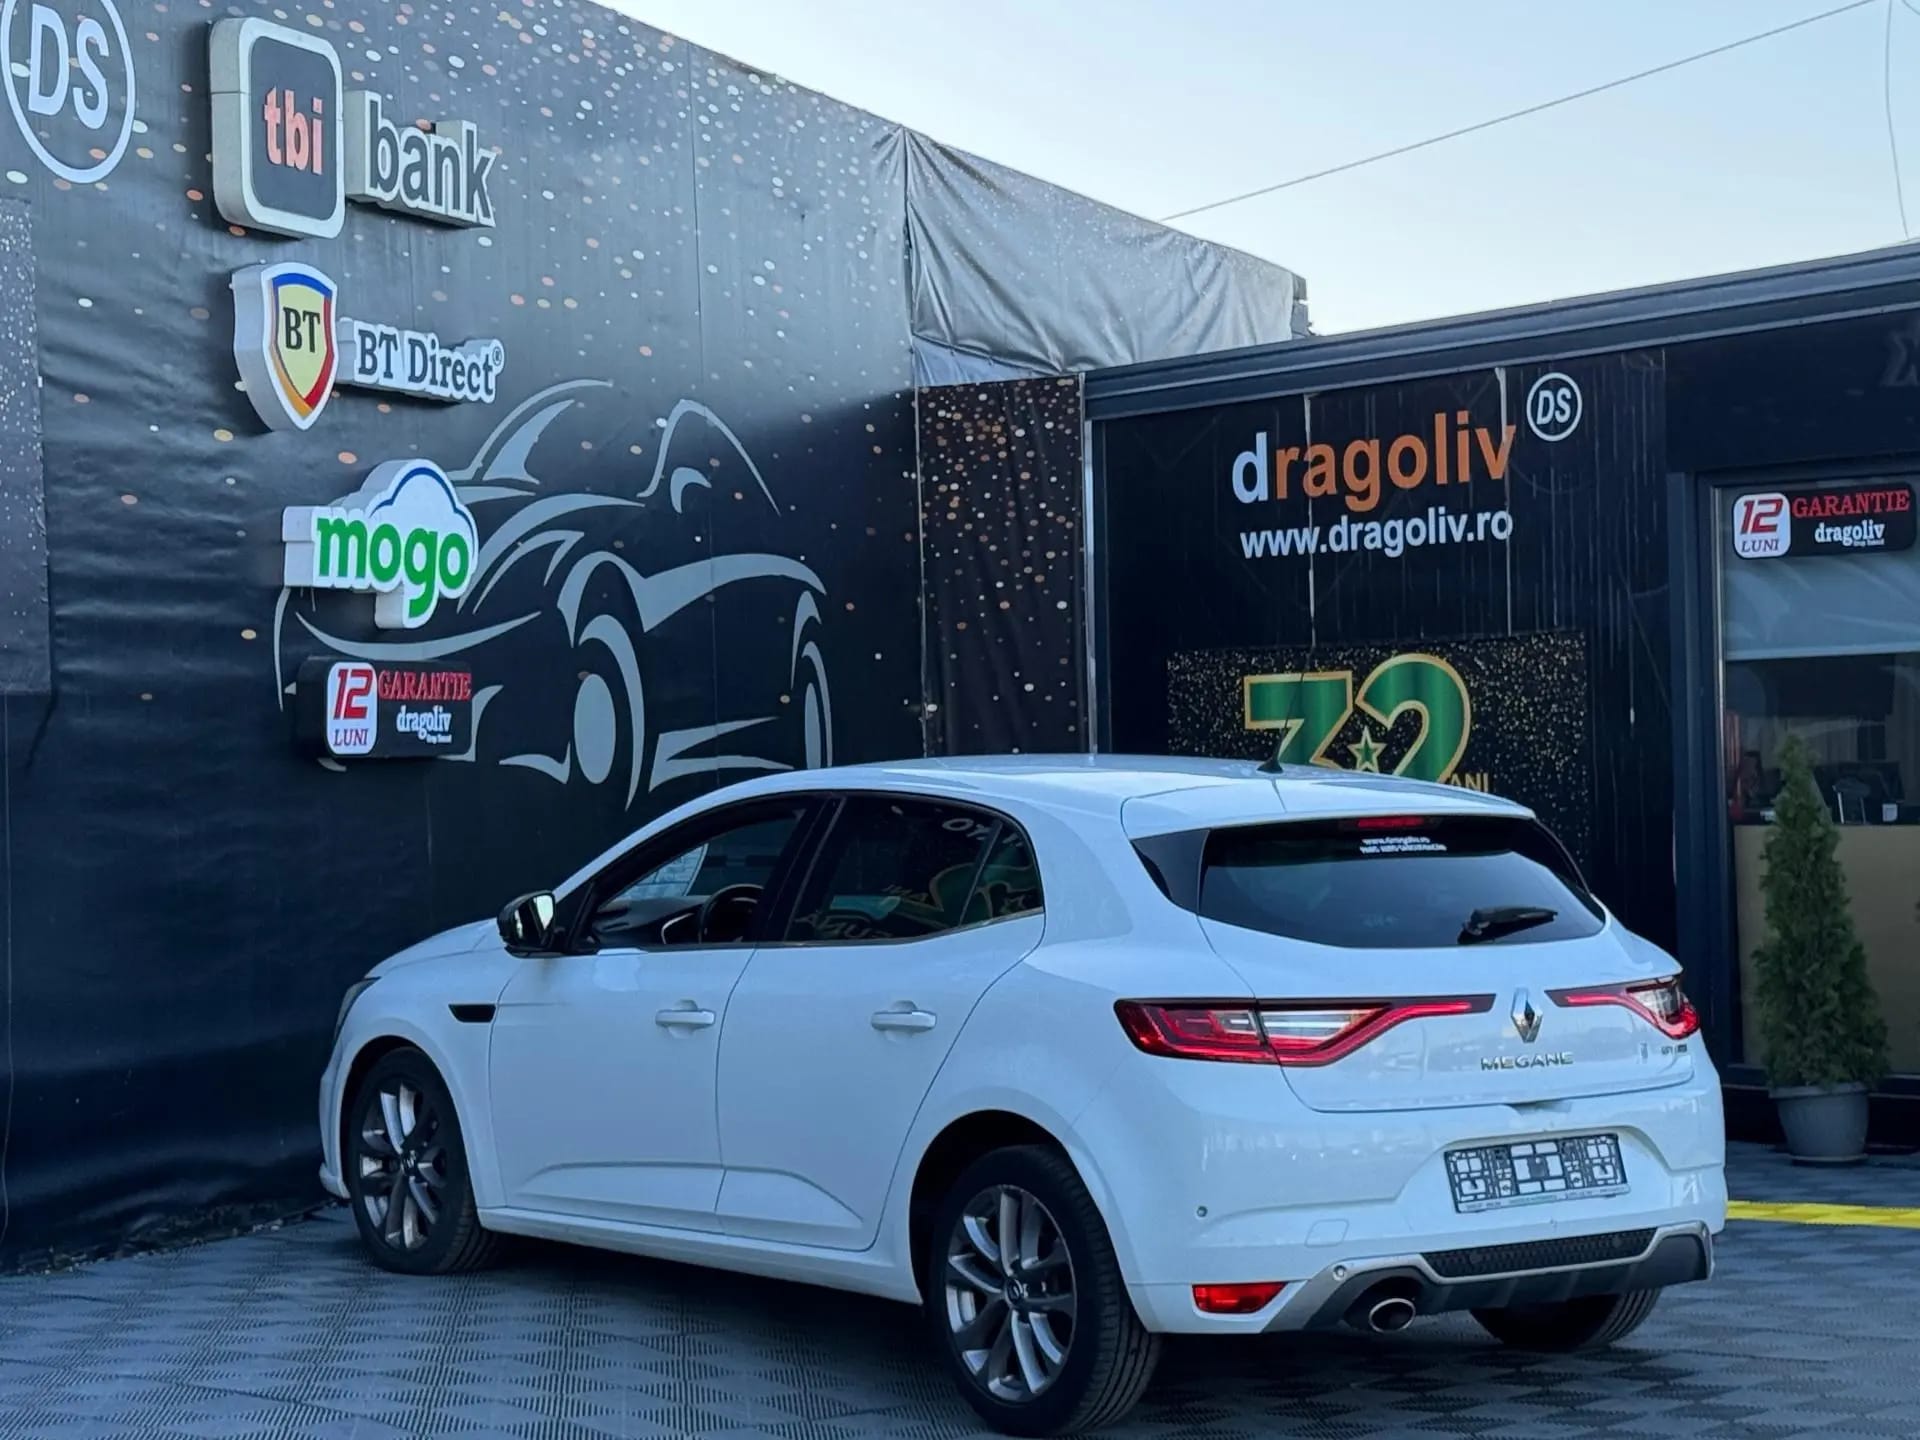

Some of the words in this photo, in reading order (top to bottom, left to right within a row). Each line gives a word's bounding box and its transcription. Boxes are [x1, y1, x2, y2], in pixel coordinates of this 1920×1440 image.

[27, 3, 111, 130] DS
[263, 86, 324, 175] tbi
[368, 100, 496, 223] bank
[283, 306, 321, 353] BT
[358, 328, 398, 380] BT
[1536, 386, 1572, 425] DS
[1232, 410, 1516, 512] dragoliv
[1741, 498, 1783, 535] 12
[1792, 489, 1911, 518] GARANTIE
[1240, 505, 1514, 558] www.dragoliv.ro
[1741, 539, 1780, 553] LUNI
[1815, 519, 1886, 547] dragoliv
[316, 517, 469, 618] mogo
[333, 668, 373, 720] 12
[377, 669, 472, 701] GARANTIE
[333, 728, 369, 747] LUNI
[396, 704, 453, 741] dragoliv
[1244, 653, 1472, 783] 32
[1480, 1051, 1574, 1071] MEGANE
